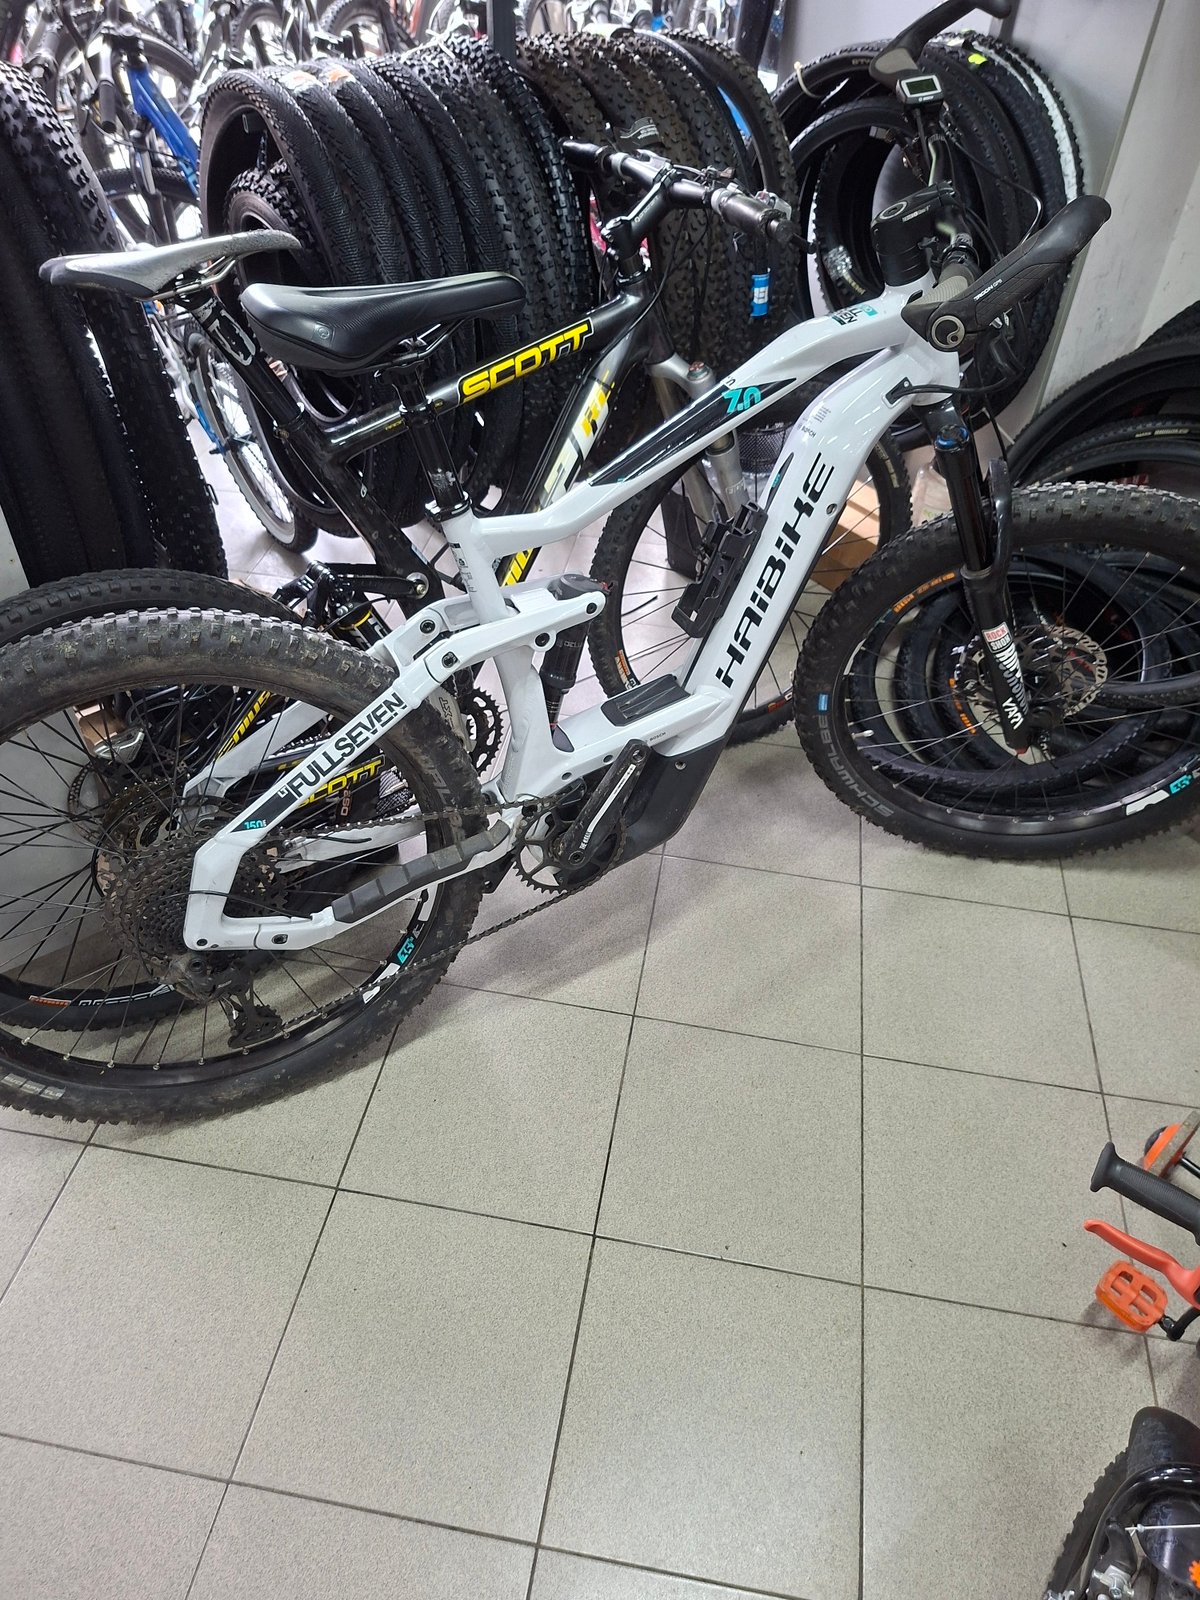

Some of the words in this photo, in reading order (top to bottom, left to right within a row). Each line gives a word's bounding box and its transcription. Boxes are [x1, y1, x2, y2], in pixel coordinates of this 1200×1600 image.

[462, 322, 589, 404] SCOTT
[721, 386, 761, 414] 7.0
[715, 452, 834, 689] HAIBIKE
[286, 691, 408, 798] FULLSEVEN
[818, 714, 895, 817] SCHWALBE
